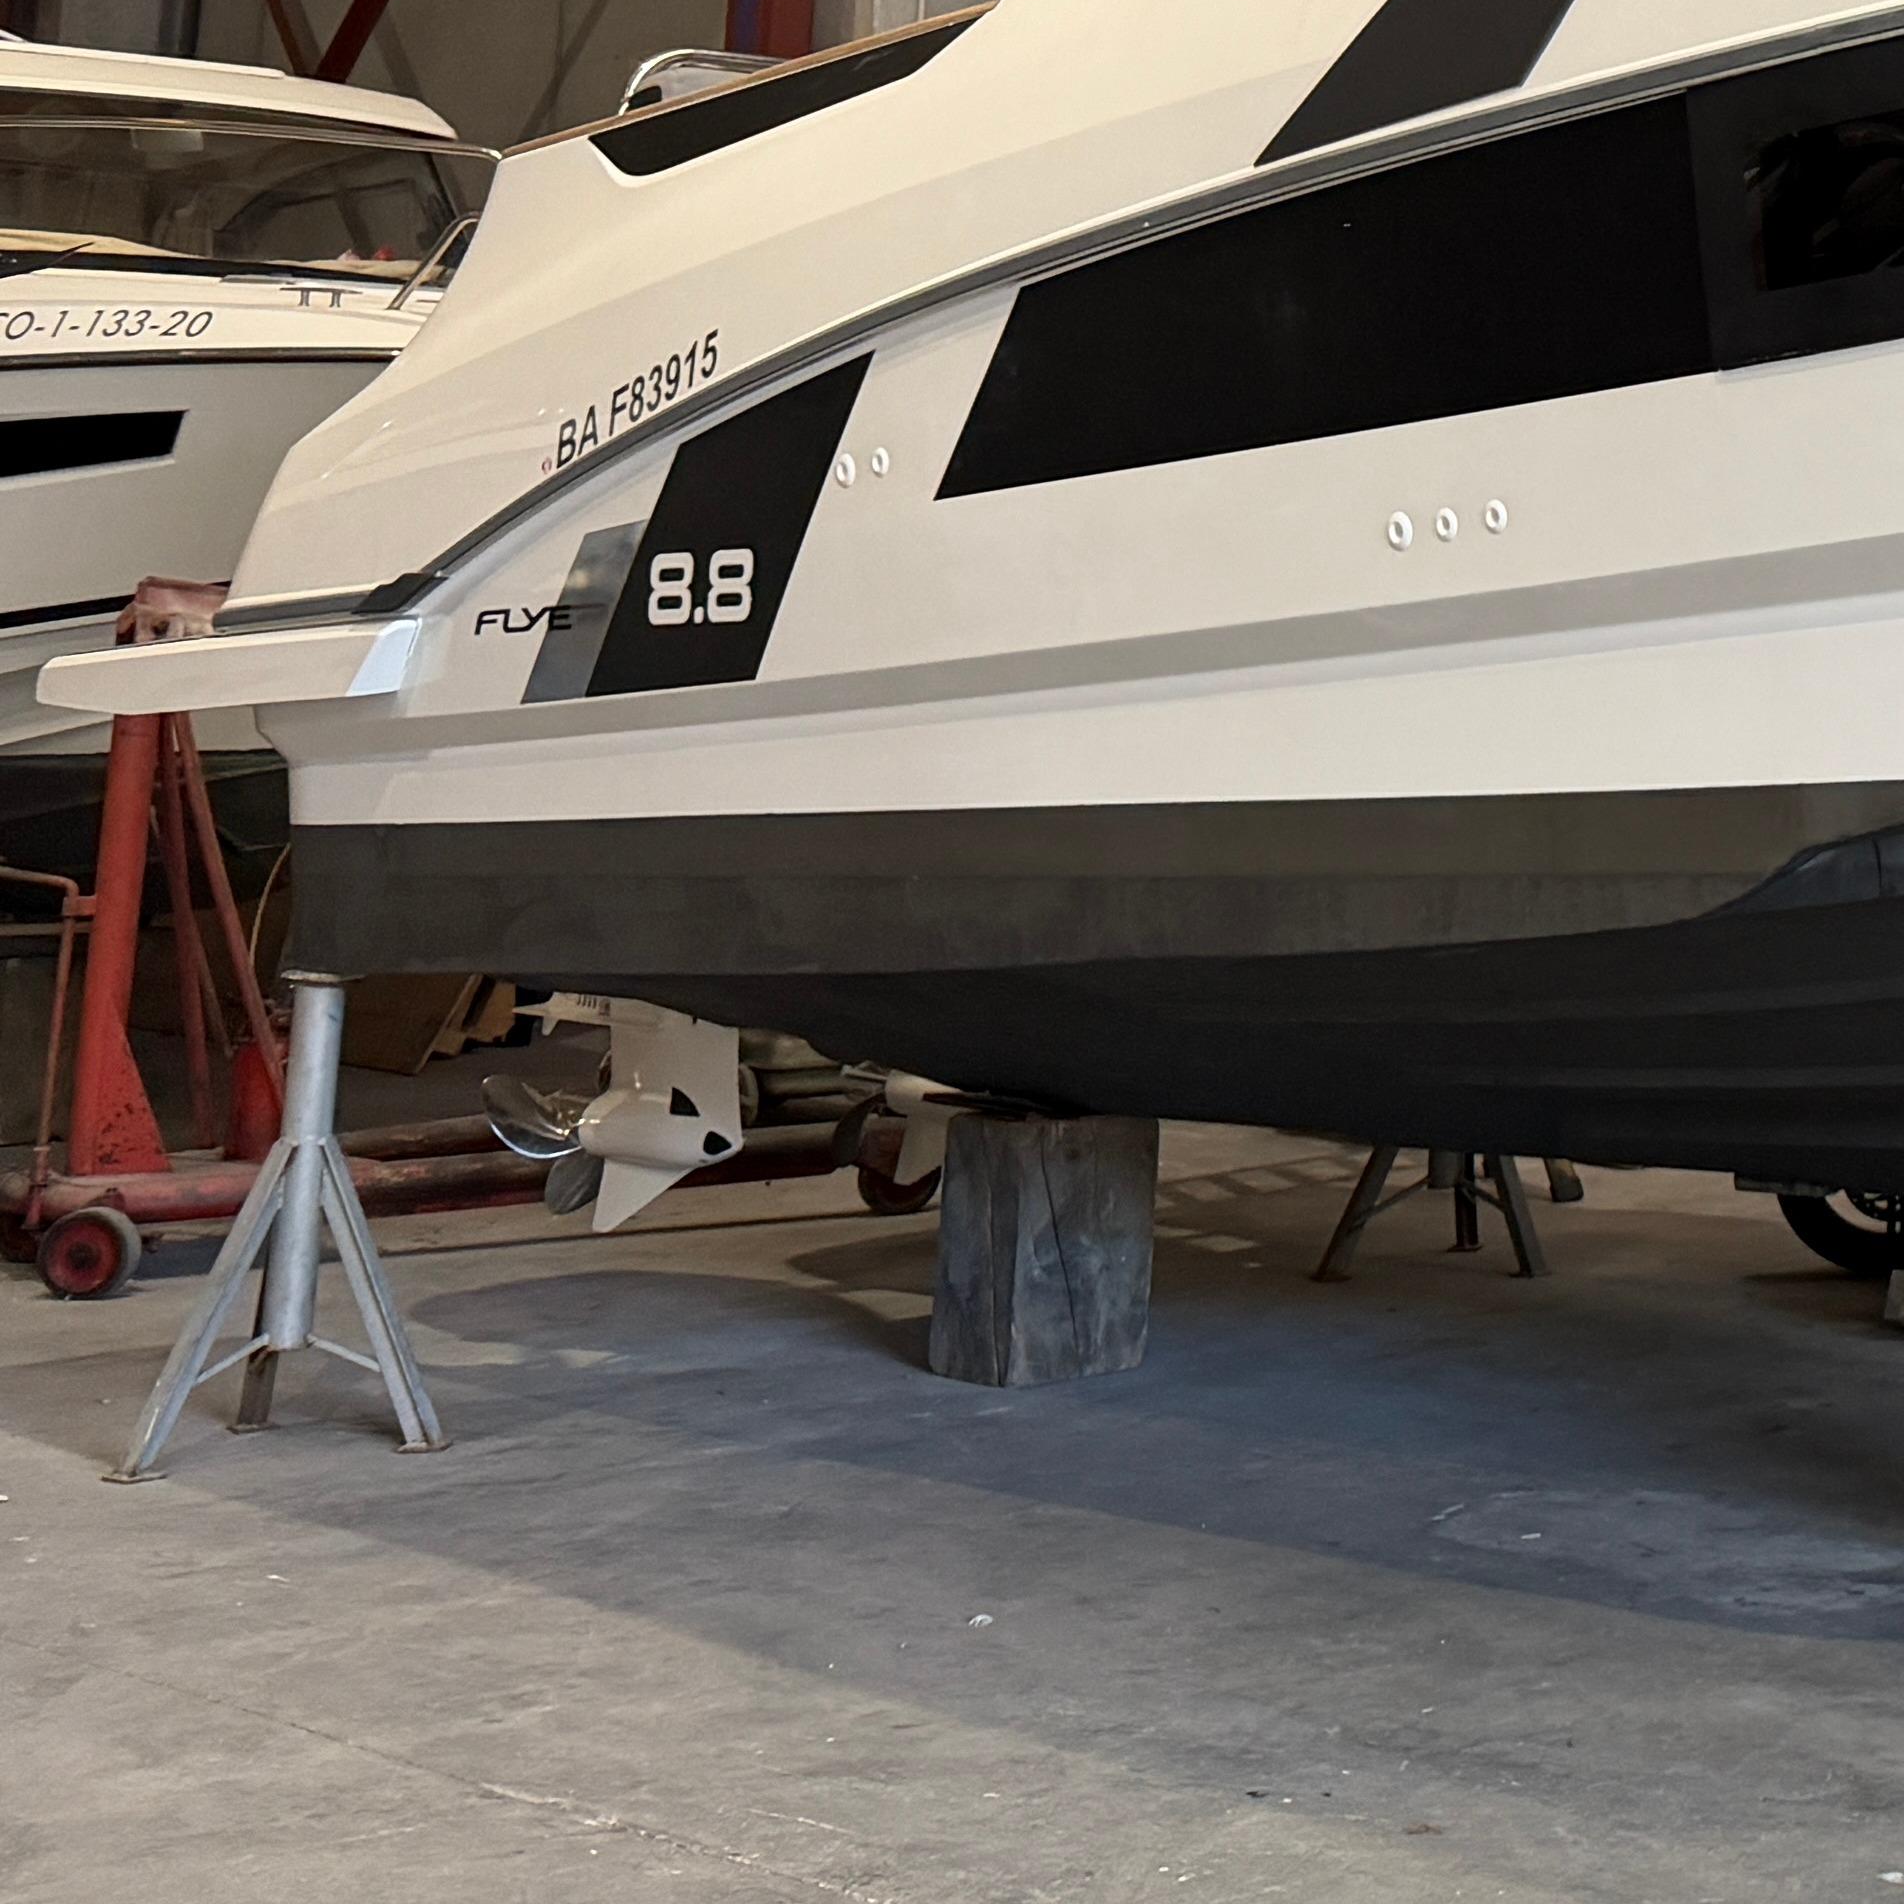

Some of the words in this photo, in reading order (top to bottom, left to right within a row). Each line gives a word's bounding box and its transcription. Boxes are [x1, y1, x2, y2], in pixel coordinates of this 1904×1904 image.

[557, 405, 598, 469] BA
[609, 328, 719, 436] F83915
[474, 603, 606, 635] FLYE
[648, 548, 754, 626] 8.8
